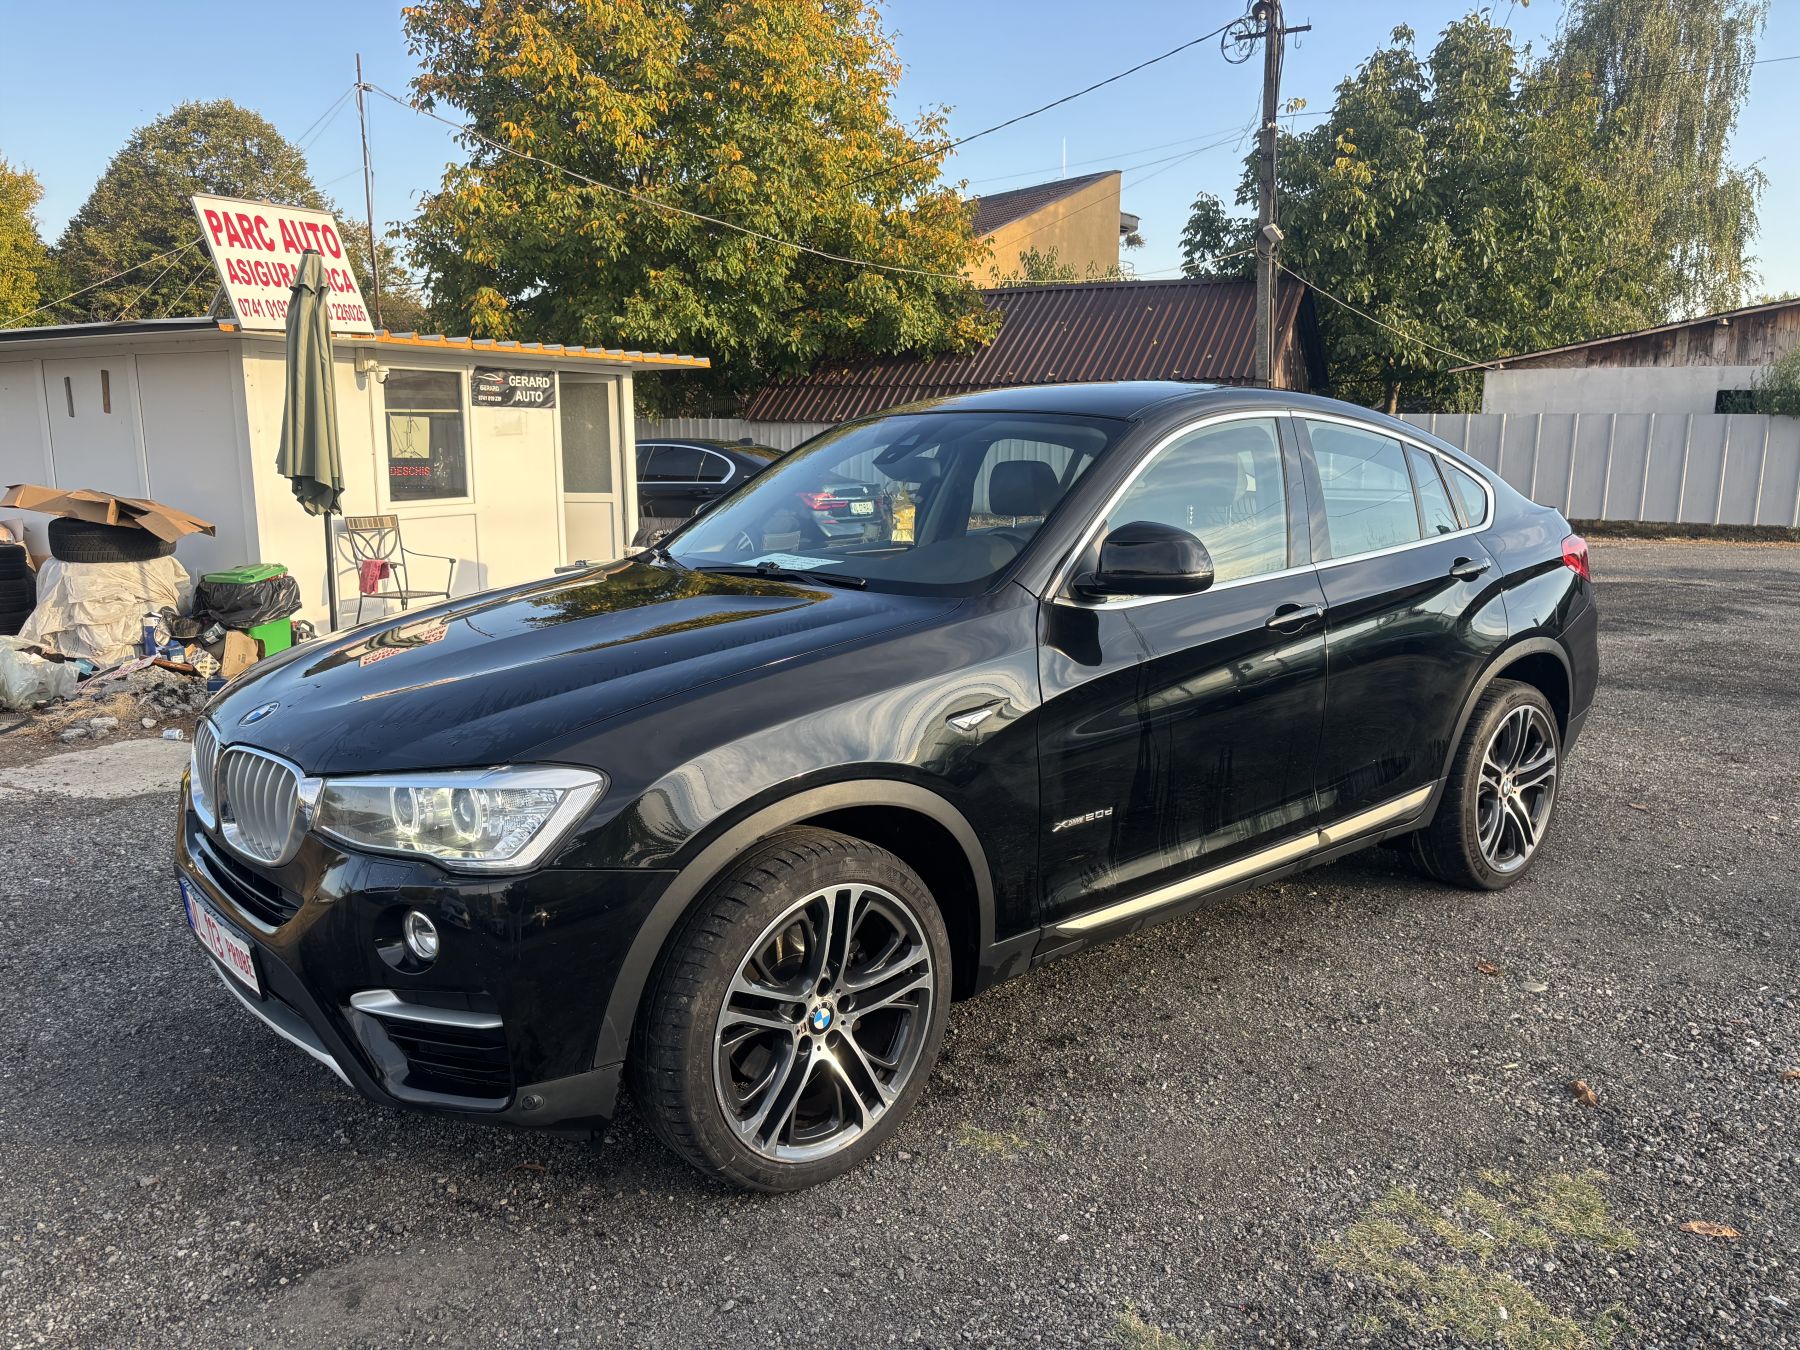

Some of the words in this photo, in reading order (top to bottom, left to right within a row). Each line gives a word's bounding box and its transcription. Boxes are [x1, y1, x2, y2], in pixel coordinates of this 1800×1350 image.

[204, 209, 275, 252] PARC
[278, 218, 342, 259] AUTO
[226, 258, 298, 288] ASIGURA
[238, 298, 266, 318] 0741
[332, 303, 366, 322] 226026
[479, 384, 500, 392] GERARD
[508, 375, 550, 388] GERARD
[515, 390, 543, 402] AUTO
[389, 466, 430, 476] DESCHIS
